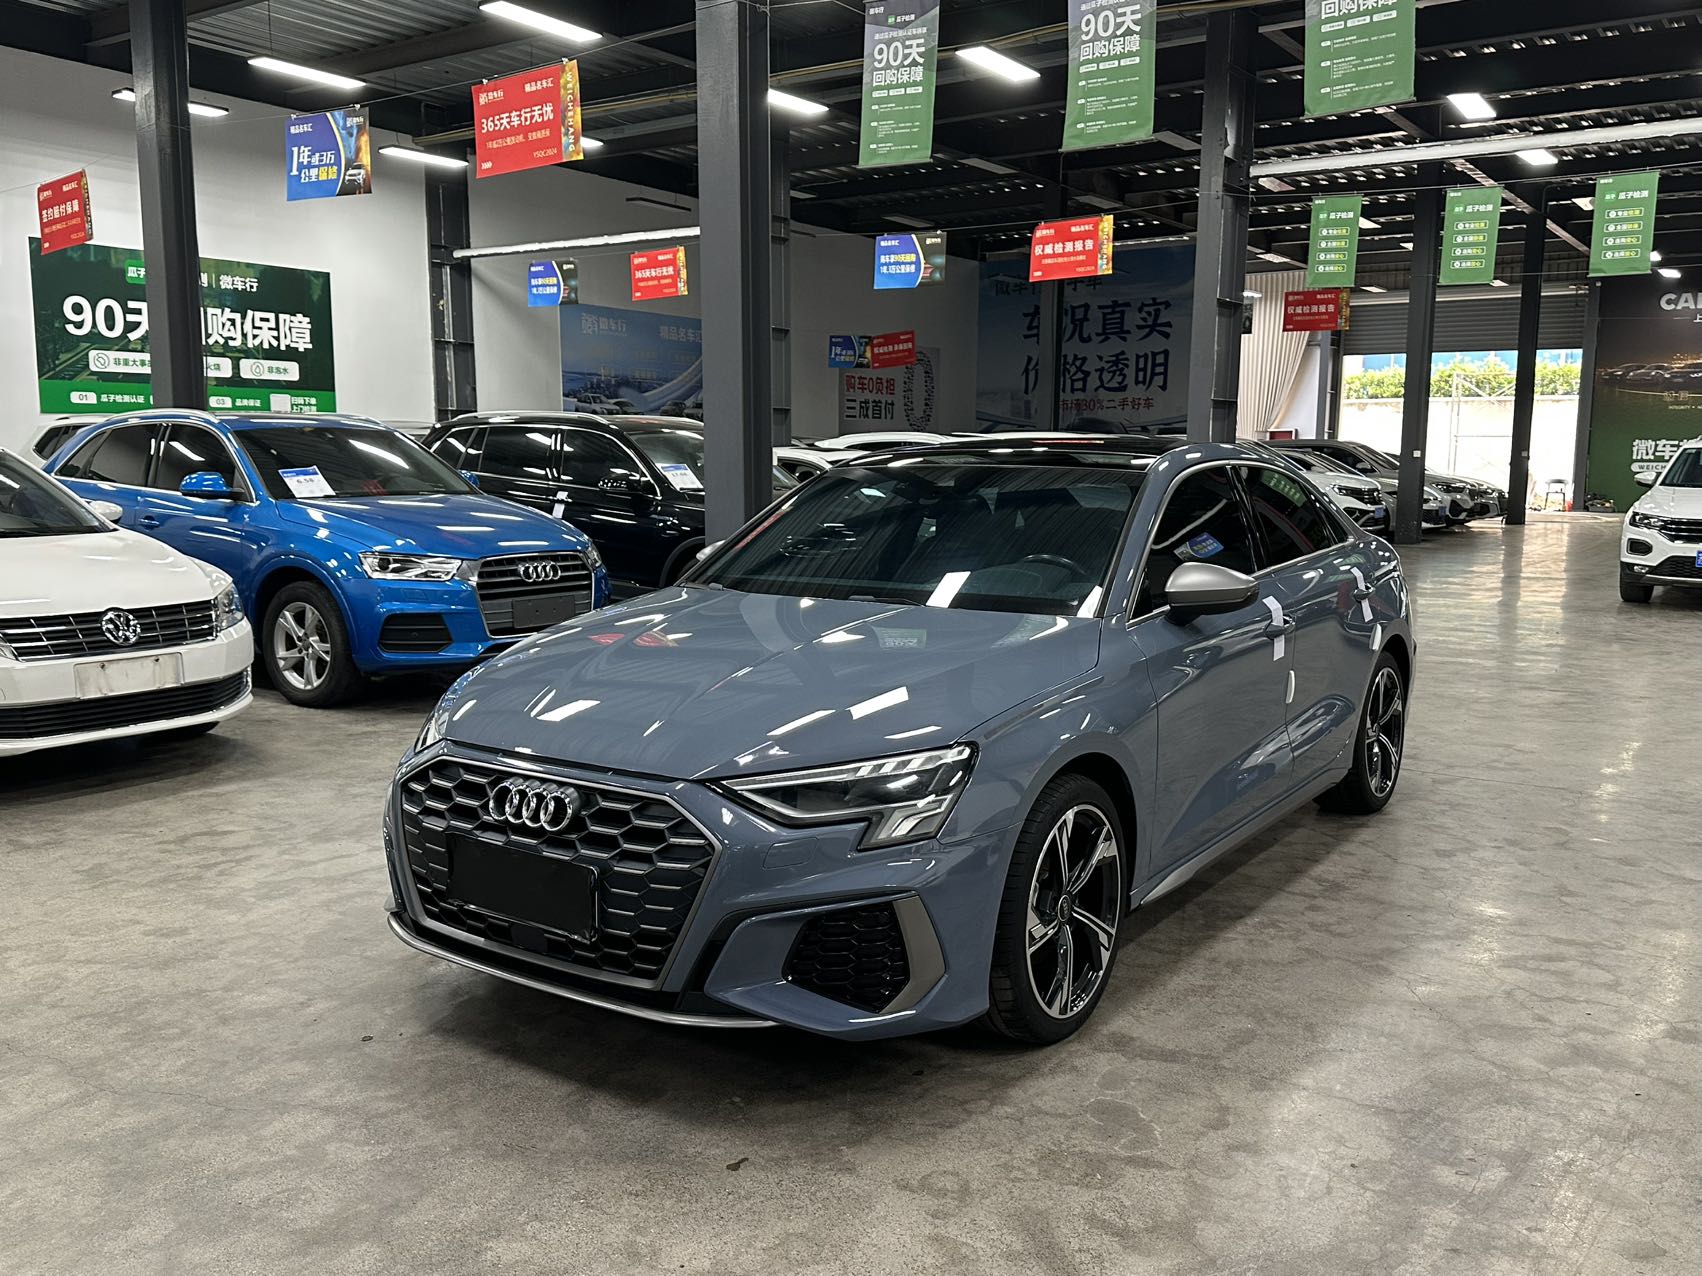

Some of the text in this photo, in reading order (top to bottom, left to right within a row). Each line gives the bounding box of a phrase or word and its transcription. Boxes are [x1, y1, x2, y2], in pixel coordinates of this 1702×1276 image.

[1081, 4, 1142, 41] 90天
[873, 38, 926, 68] 90天
[1080, 34, 1141, 62] 回购保障
[524, 77, 554, 94] 精品名车汇
[872, 65, 924, 87] 回购保障
[481, 103, 554, 134] 365天车行无忧
[566, 71, 576, 152] WEICHEHANG
[1618, 189, 1649, 200] 瓜子检测
[1034, 238, 1095, 257] 权威检测报告
[219, 274, 259, 292] 微车行
[62, 295, 313, 352] 90天购保障
[845, 374, 896, 395] 购车0负担
[78, 393, 89, 401] 01
[100, 394, 145, 403] 瓜子检测认证
[845, 398, 895, 420] 三成首付
[1632, 439, 1691, 460] 微车
